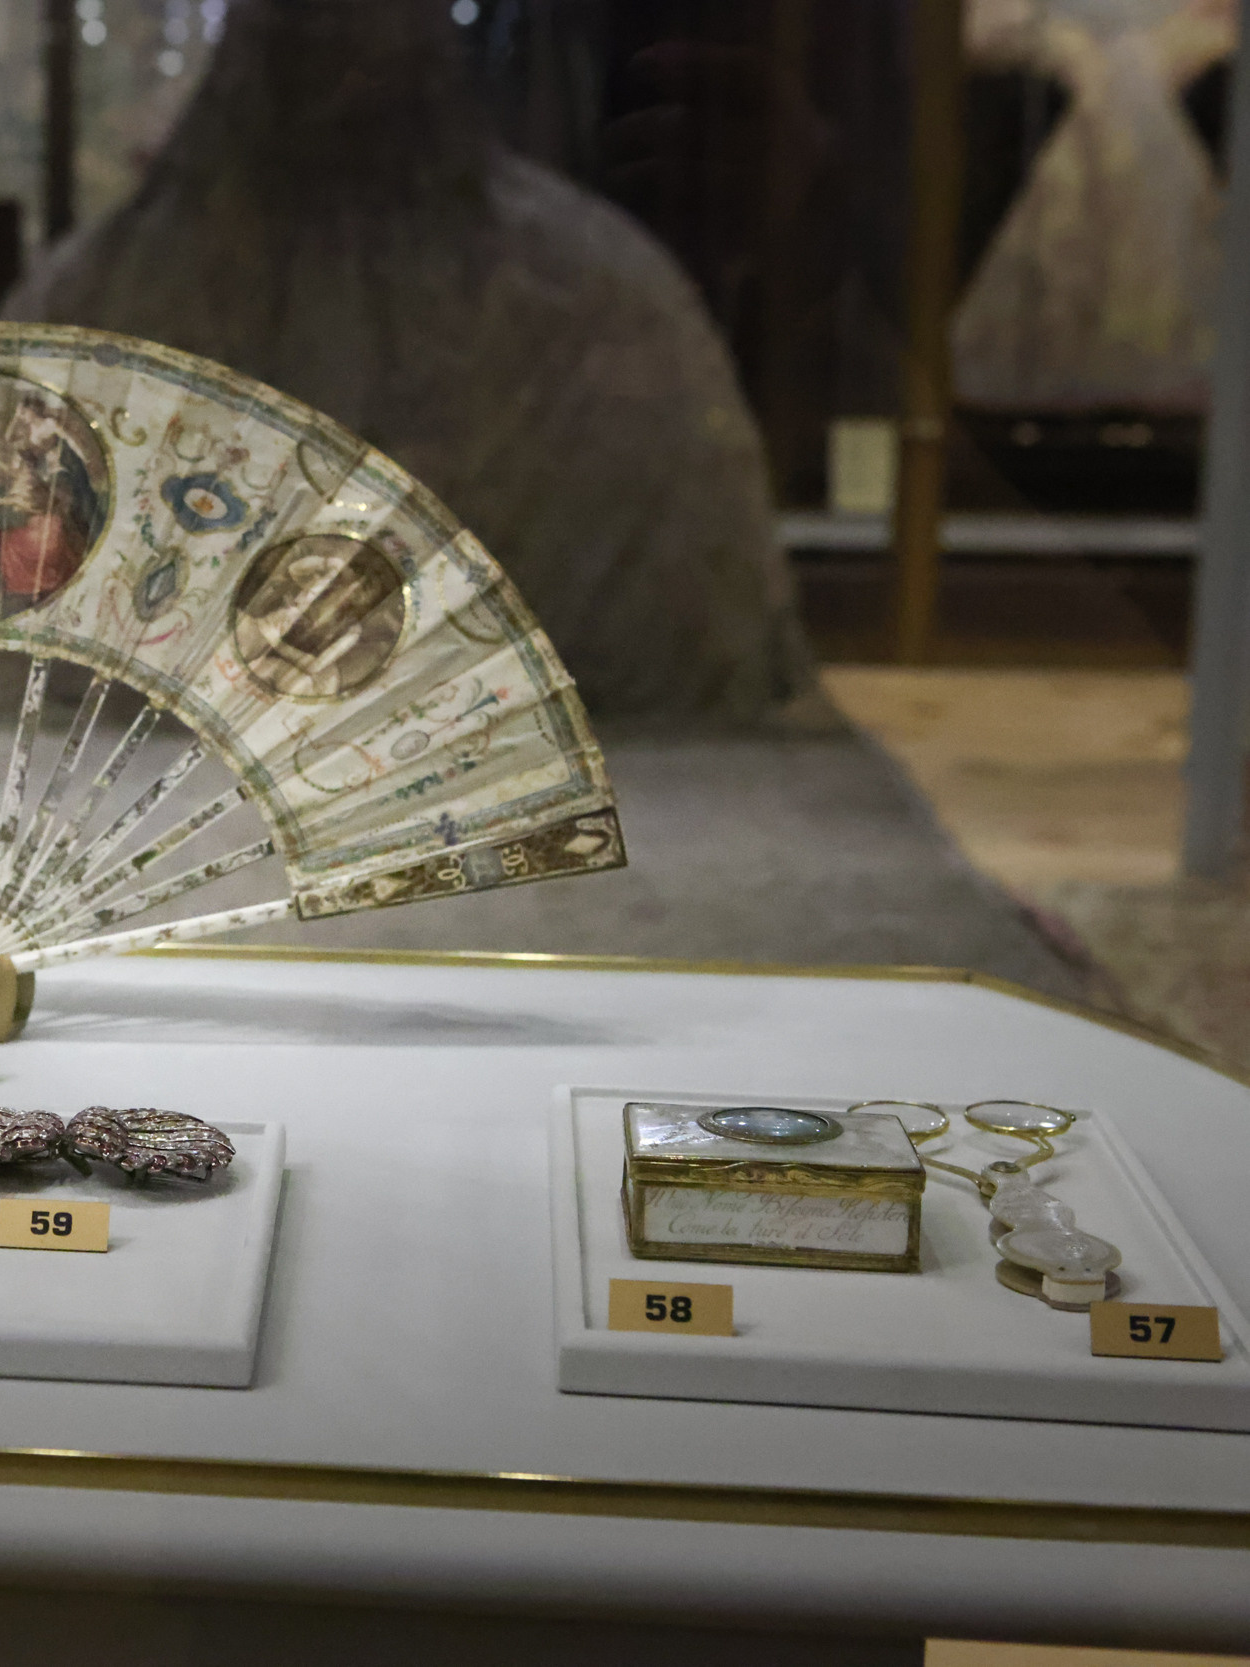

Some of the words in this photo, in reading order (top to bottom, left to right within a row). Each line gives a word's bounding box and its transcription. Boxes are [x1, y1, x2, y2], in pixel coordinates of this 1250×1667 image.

[30, 1210, 73, 1237] 59
[646, 1294, 692, 1322] 58
[1129, 1315, 1176, 1343] 57
